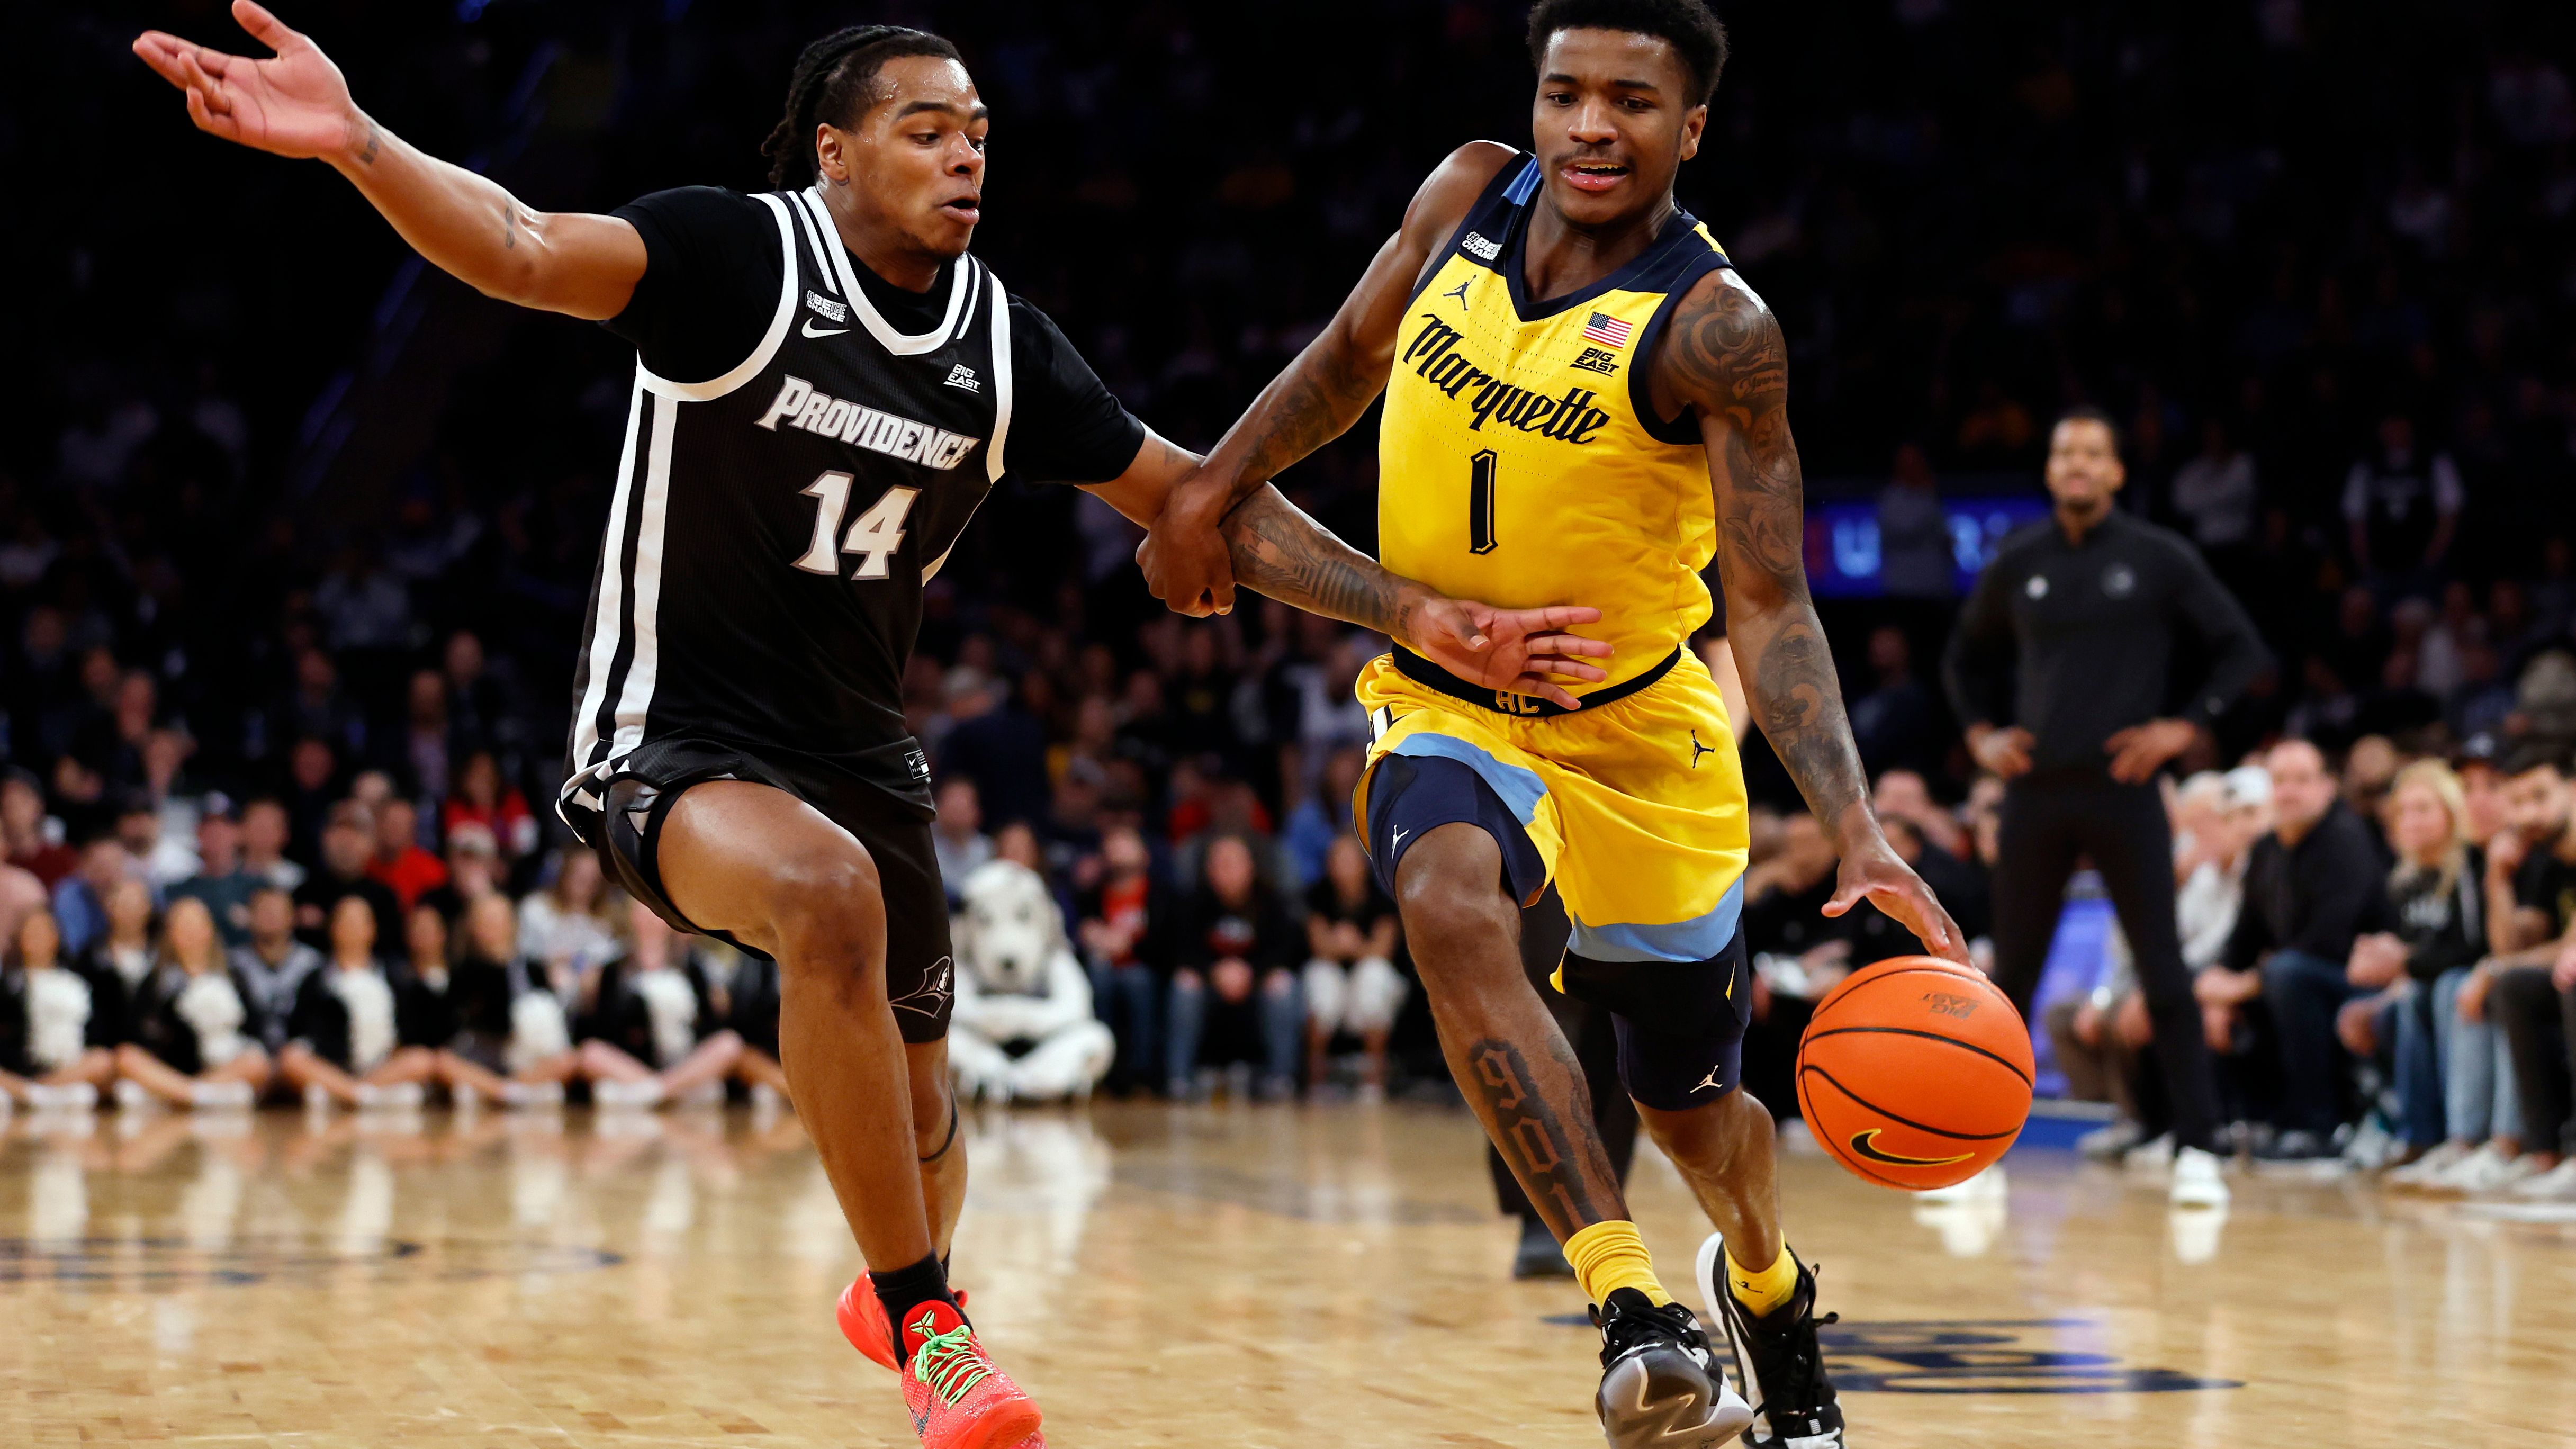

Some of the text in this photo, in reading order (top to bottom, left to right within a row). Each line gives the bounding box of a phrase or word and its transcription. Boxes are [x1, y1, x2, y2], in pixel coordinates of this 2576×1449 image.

[1462, 240, 1497, 260] CHANG
[807, 300, 845, 322] CHANGE
[1574, 355, 1620, 373] EAST
[1582, 347, 1616, 362] BIG
[947, 372, 981, 389] EAST
[952, 363, 975, 378] BIG
[1402, 313, 1610, 444] Marquette
[754, 374, 980, 470] PROVIDENCE
[1469, 448, 1498, 555] 1
[790, 469, 922, 581] 14
[1475, 1048, 1591, 1234] 901
